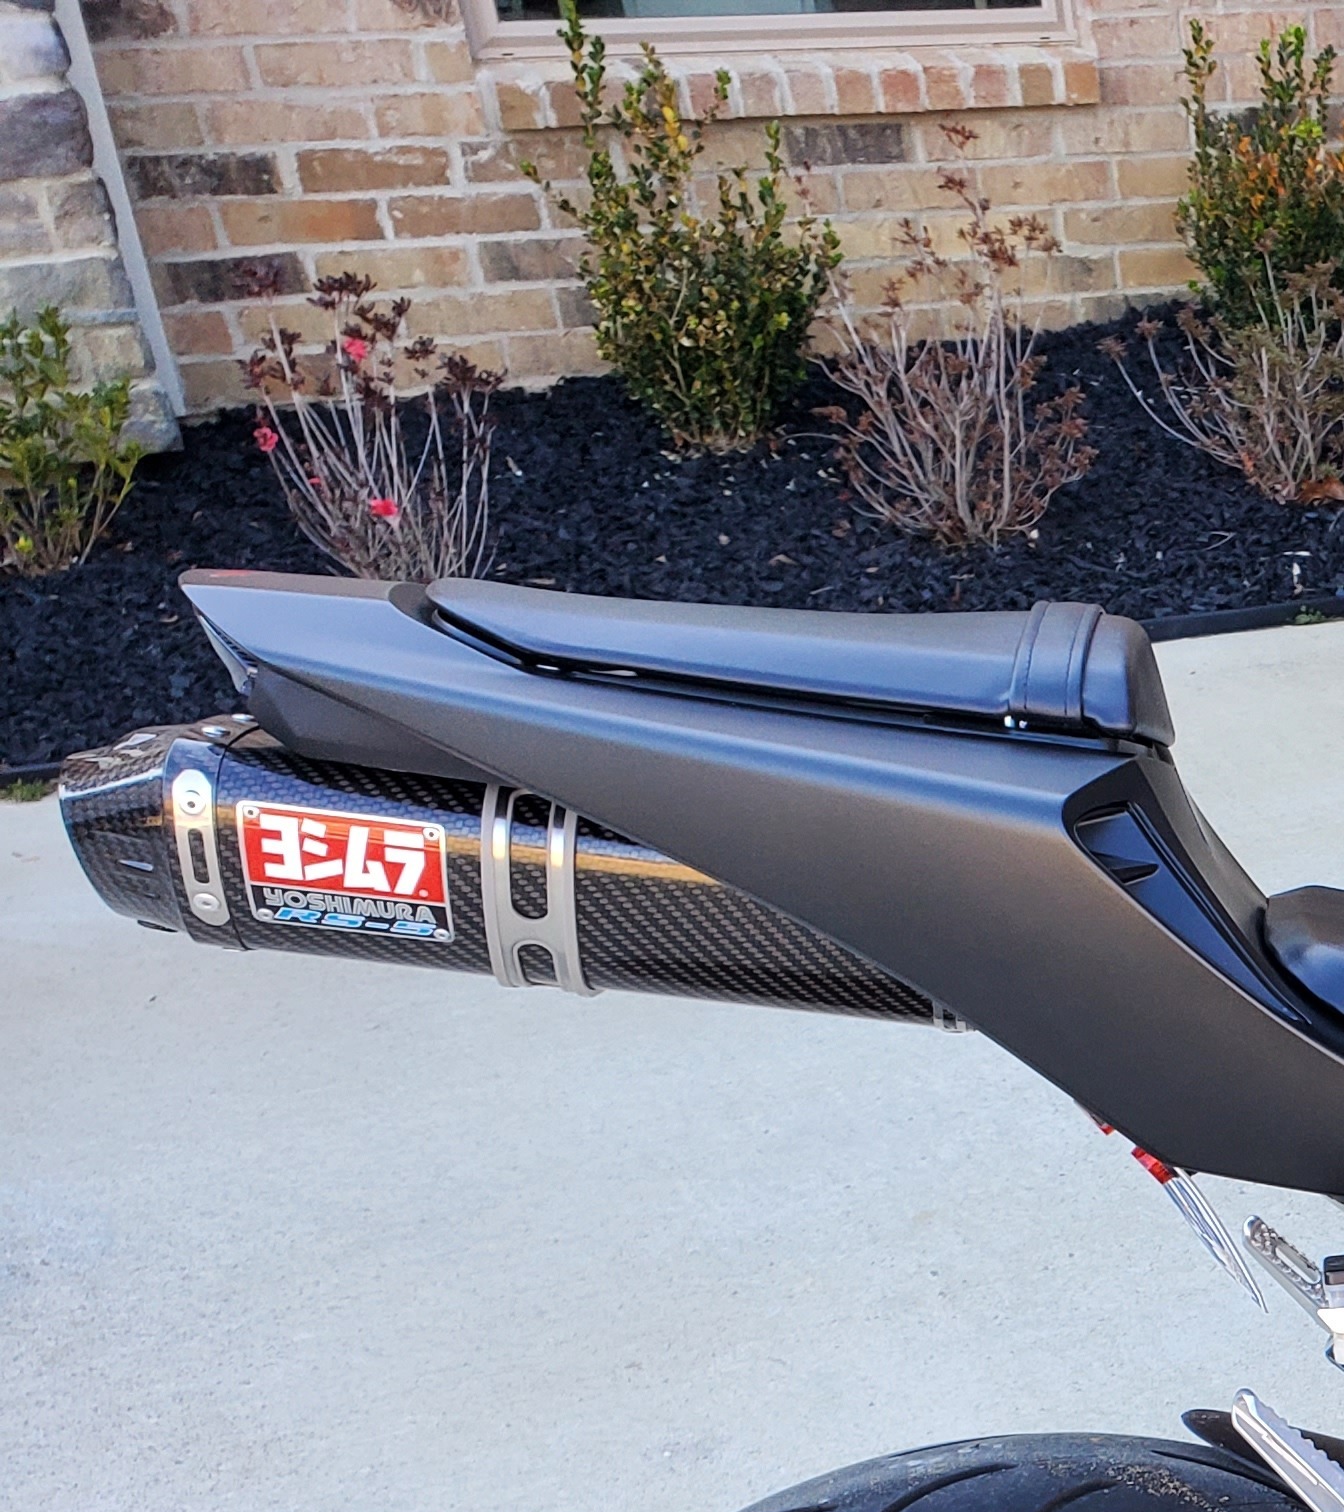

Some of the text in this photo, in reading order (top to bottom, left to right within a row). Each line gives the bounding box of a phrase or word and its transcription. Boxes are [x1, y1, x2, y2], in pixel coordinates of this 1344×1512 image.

[259, 813, 426, 896] ヨシムラ
[262, 887, 437, 925] YOSHIMURA
[273, 907, 437, 937] RS-5
